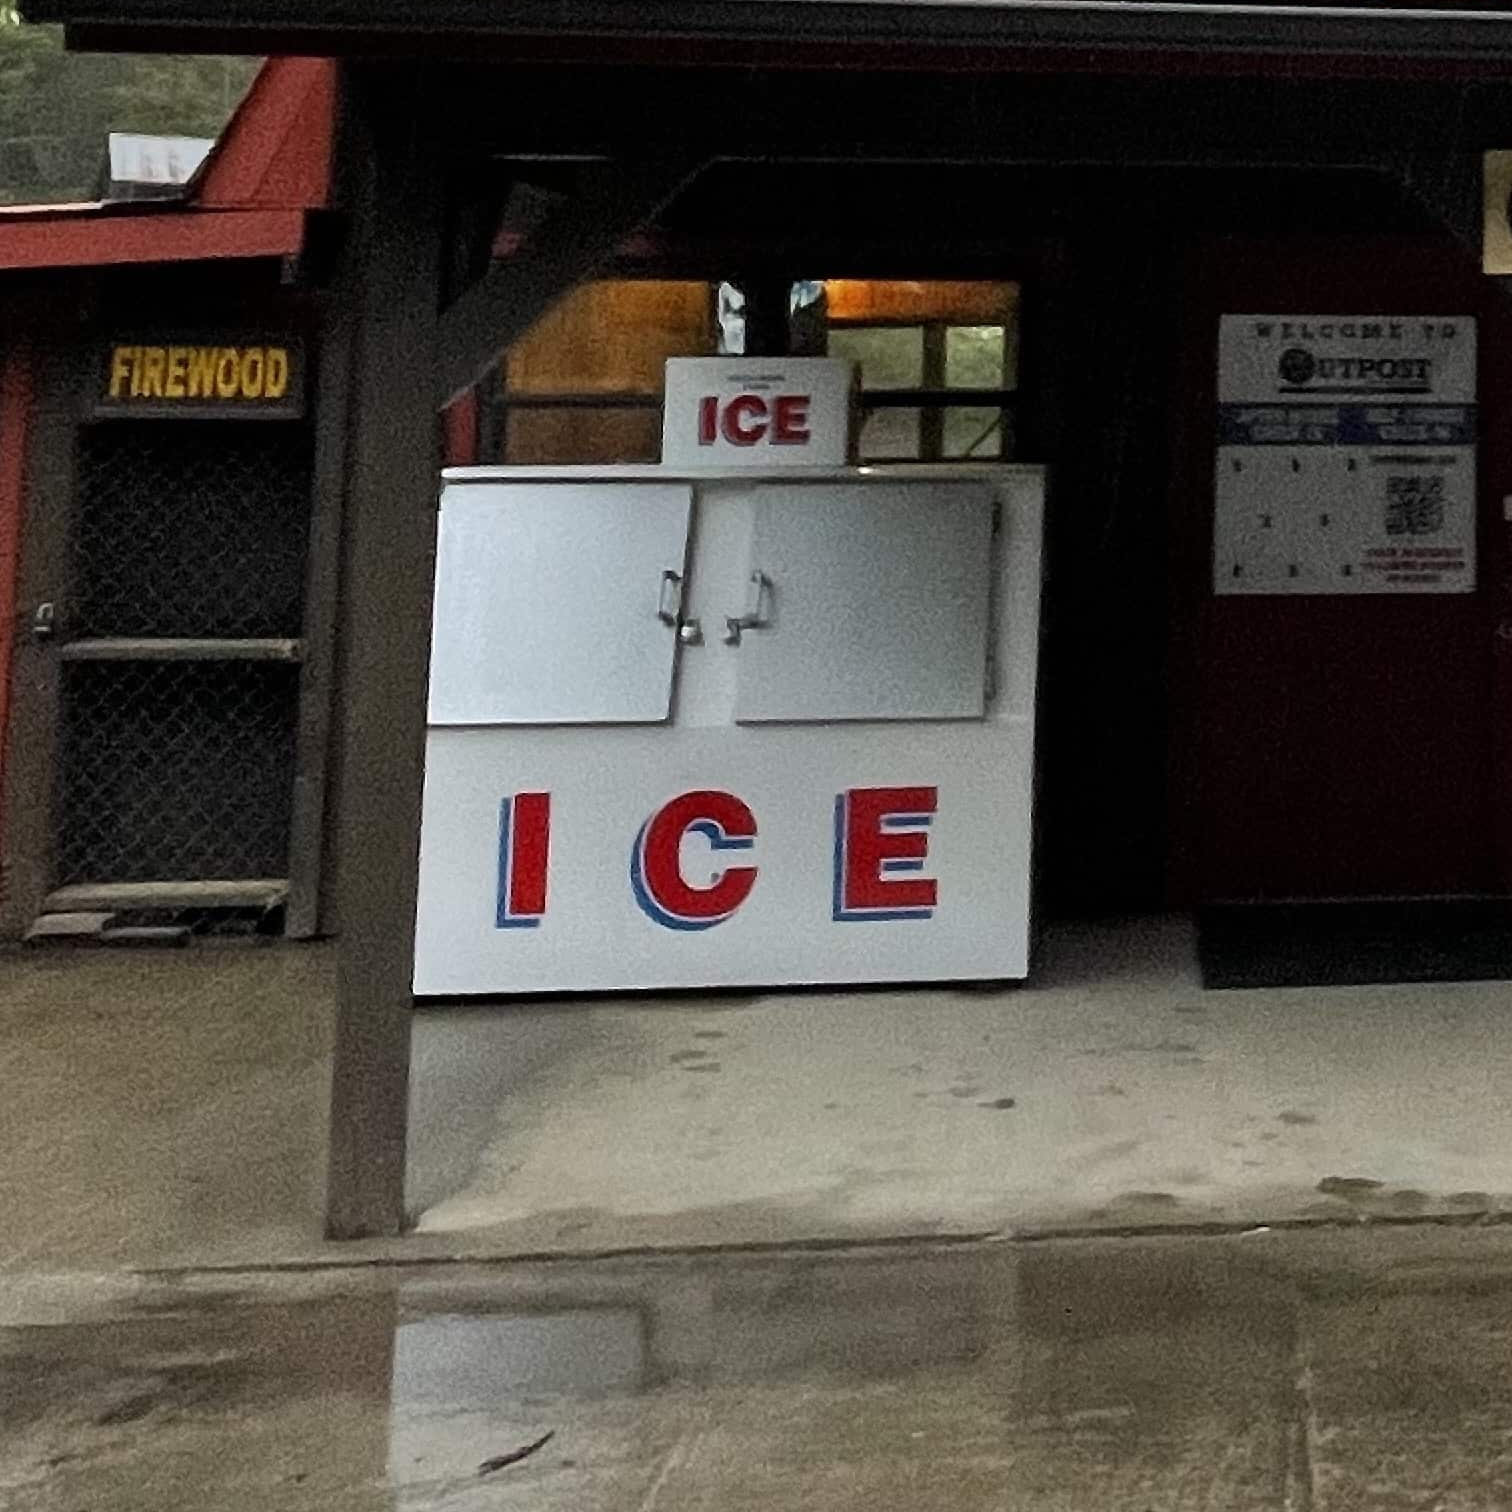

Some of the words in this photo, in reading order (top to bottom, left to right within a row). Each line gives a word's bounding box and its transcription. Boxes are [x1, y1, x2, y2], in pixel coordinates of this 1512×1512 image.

[109, 346, 288, 399] FIREWOOD
[698, 394, 812, 447] ICE
[495, 786, 938, 931] ICE
